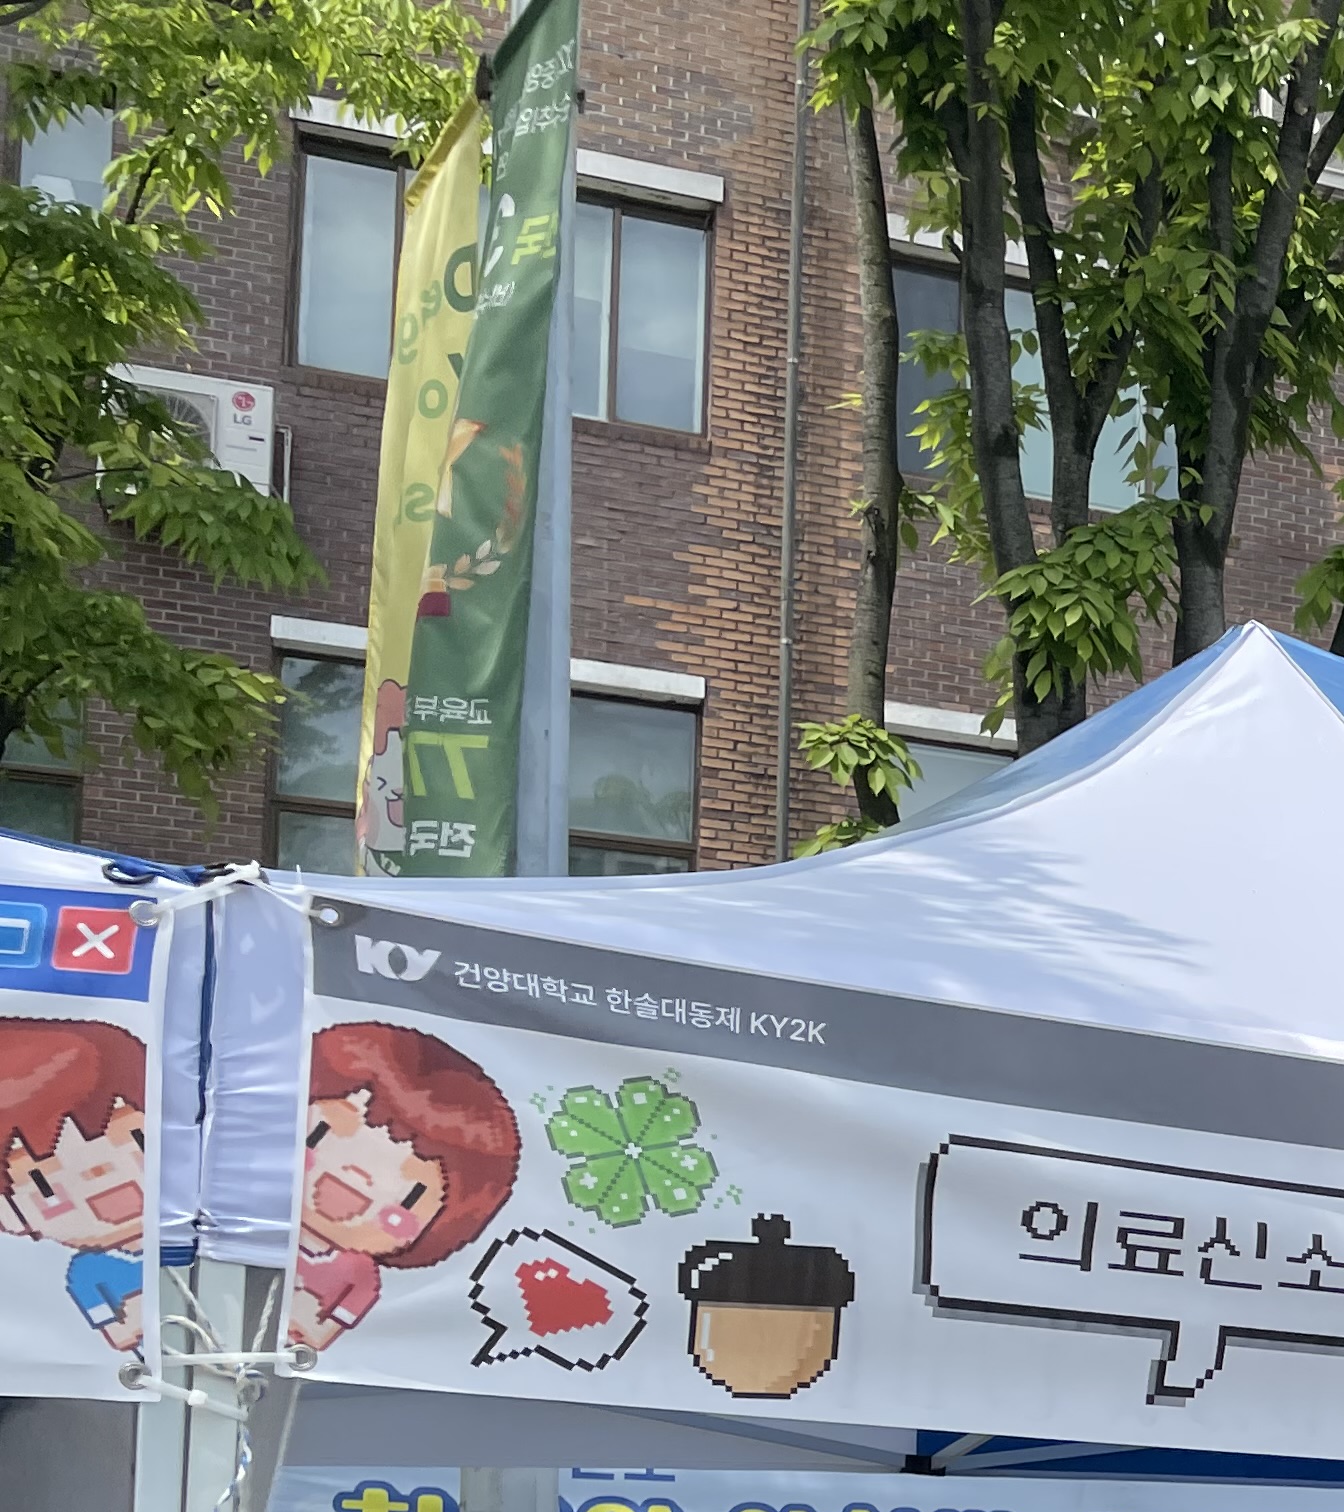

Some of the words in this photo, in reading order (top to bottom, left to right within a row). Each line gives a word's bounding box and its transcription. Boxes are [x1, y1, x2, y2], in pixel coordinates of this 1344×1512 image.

[233, 413, 252, 426] LG
[454, 960, 598, 1008] 건양대학교
[605, 987, 742, 1036] 한솔대동제
[749, 1011, 827, 1045] KY2K
